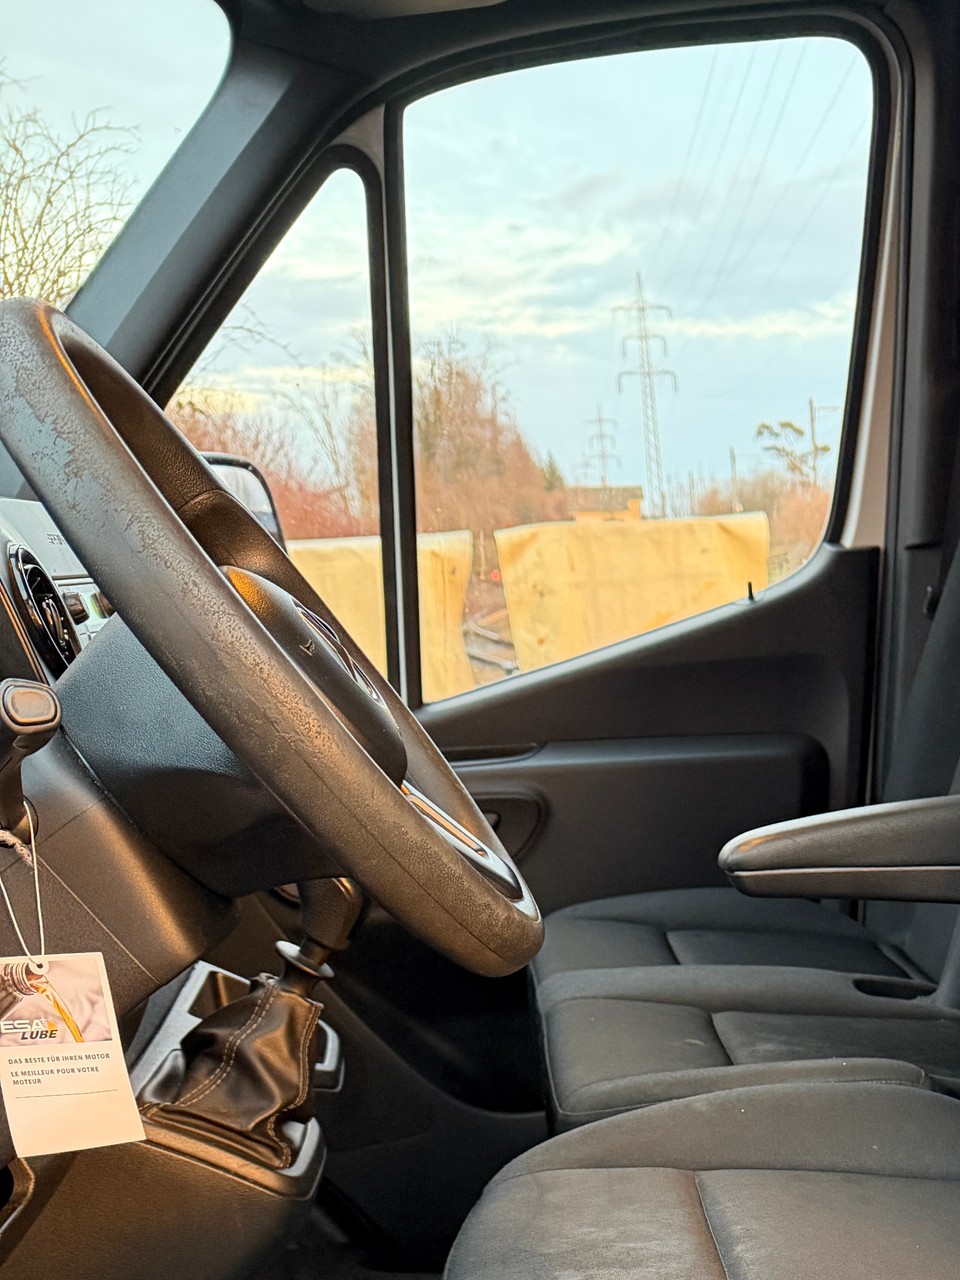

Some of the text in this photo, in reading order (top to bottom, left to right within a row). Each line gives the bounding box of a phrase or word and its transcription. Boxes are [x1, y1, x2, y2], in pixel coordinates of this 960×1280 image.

[20, 1029, 58, 1040] LUBE
[8, 1057, 22, 1065] DAS
[47, 1054, 60, 1062] FÜR
[62, 1054, 83, 1062] IHREN
[20, 1069, 55, 1077] MEILLEUR
